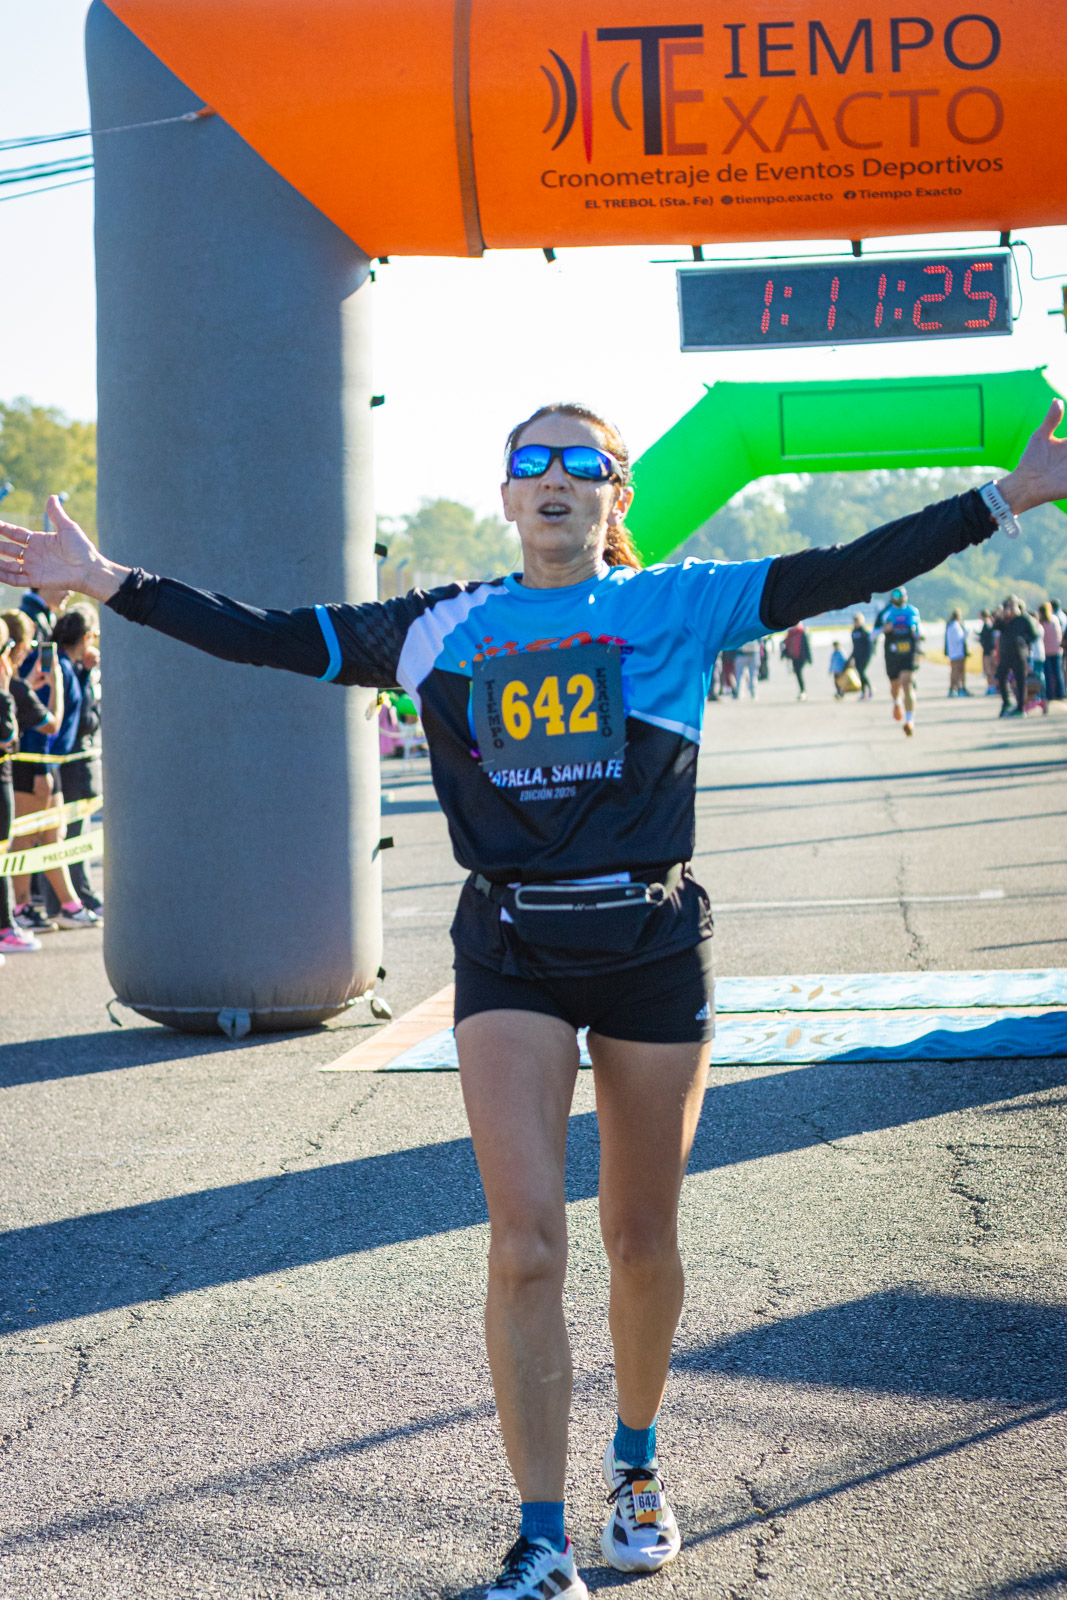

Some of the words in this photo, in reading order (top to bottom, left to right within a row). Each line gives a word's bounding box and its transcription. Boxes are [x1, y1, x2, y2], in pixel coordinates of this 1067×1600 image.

[541, 165, 710, 188] Cronometraje
[716, 163, 748, 183] de
[756, 161, 855, 181] Eventos
[863, 154, 1004, 179] Deportivos
[585, 200, 600, 209] EL
[693, 196, 714, 206] Fe)
[735, 191, 833, 205] tiempo.exacto
[858, 188, 912, 201] Tiempo
[915, 186, 962, 198] Exacto
[485, 679, 505, 749] TIEMPO
[501, 673, 598, 740] 642
[596, 667, 613, 738] EXACTO
[488, 766, 548, 788] AFAELA,
[551, 761, 603, 783] SANTA
[604, 759, 624, 779] FE
[519, 788, 553, 802] EDICIÓN
[638, 1494, 658, 1509] 642
